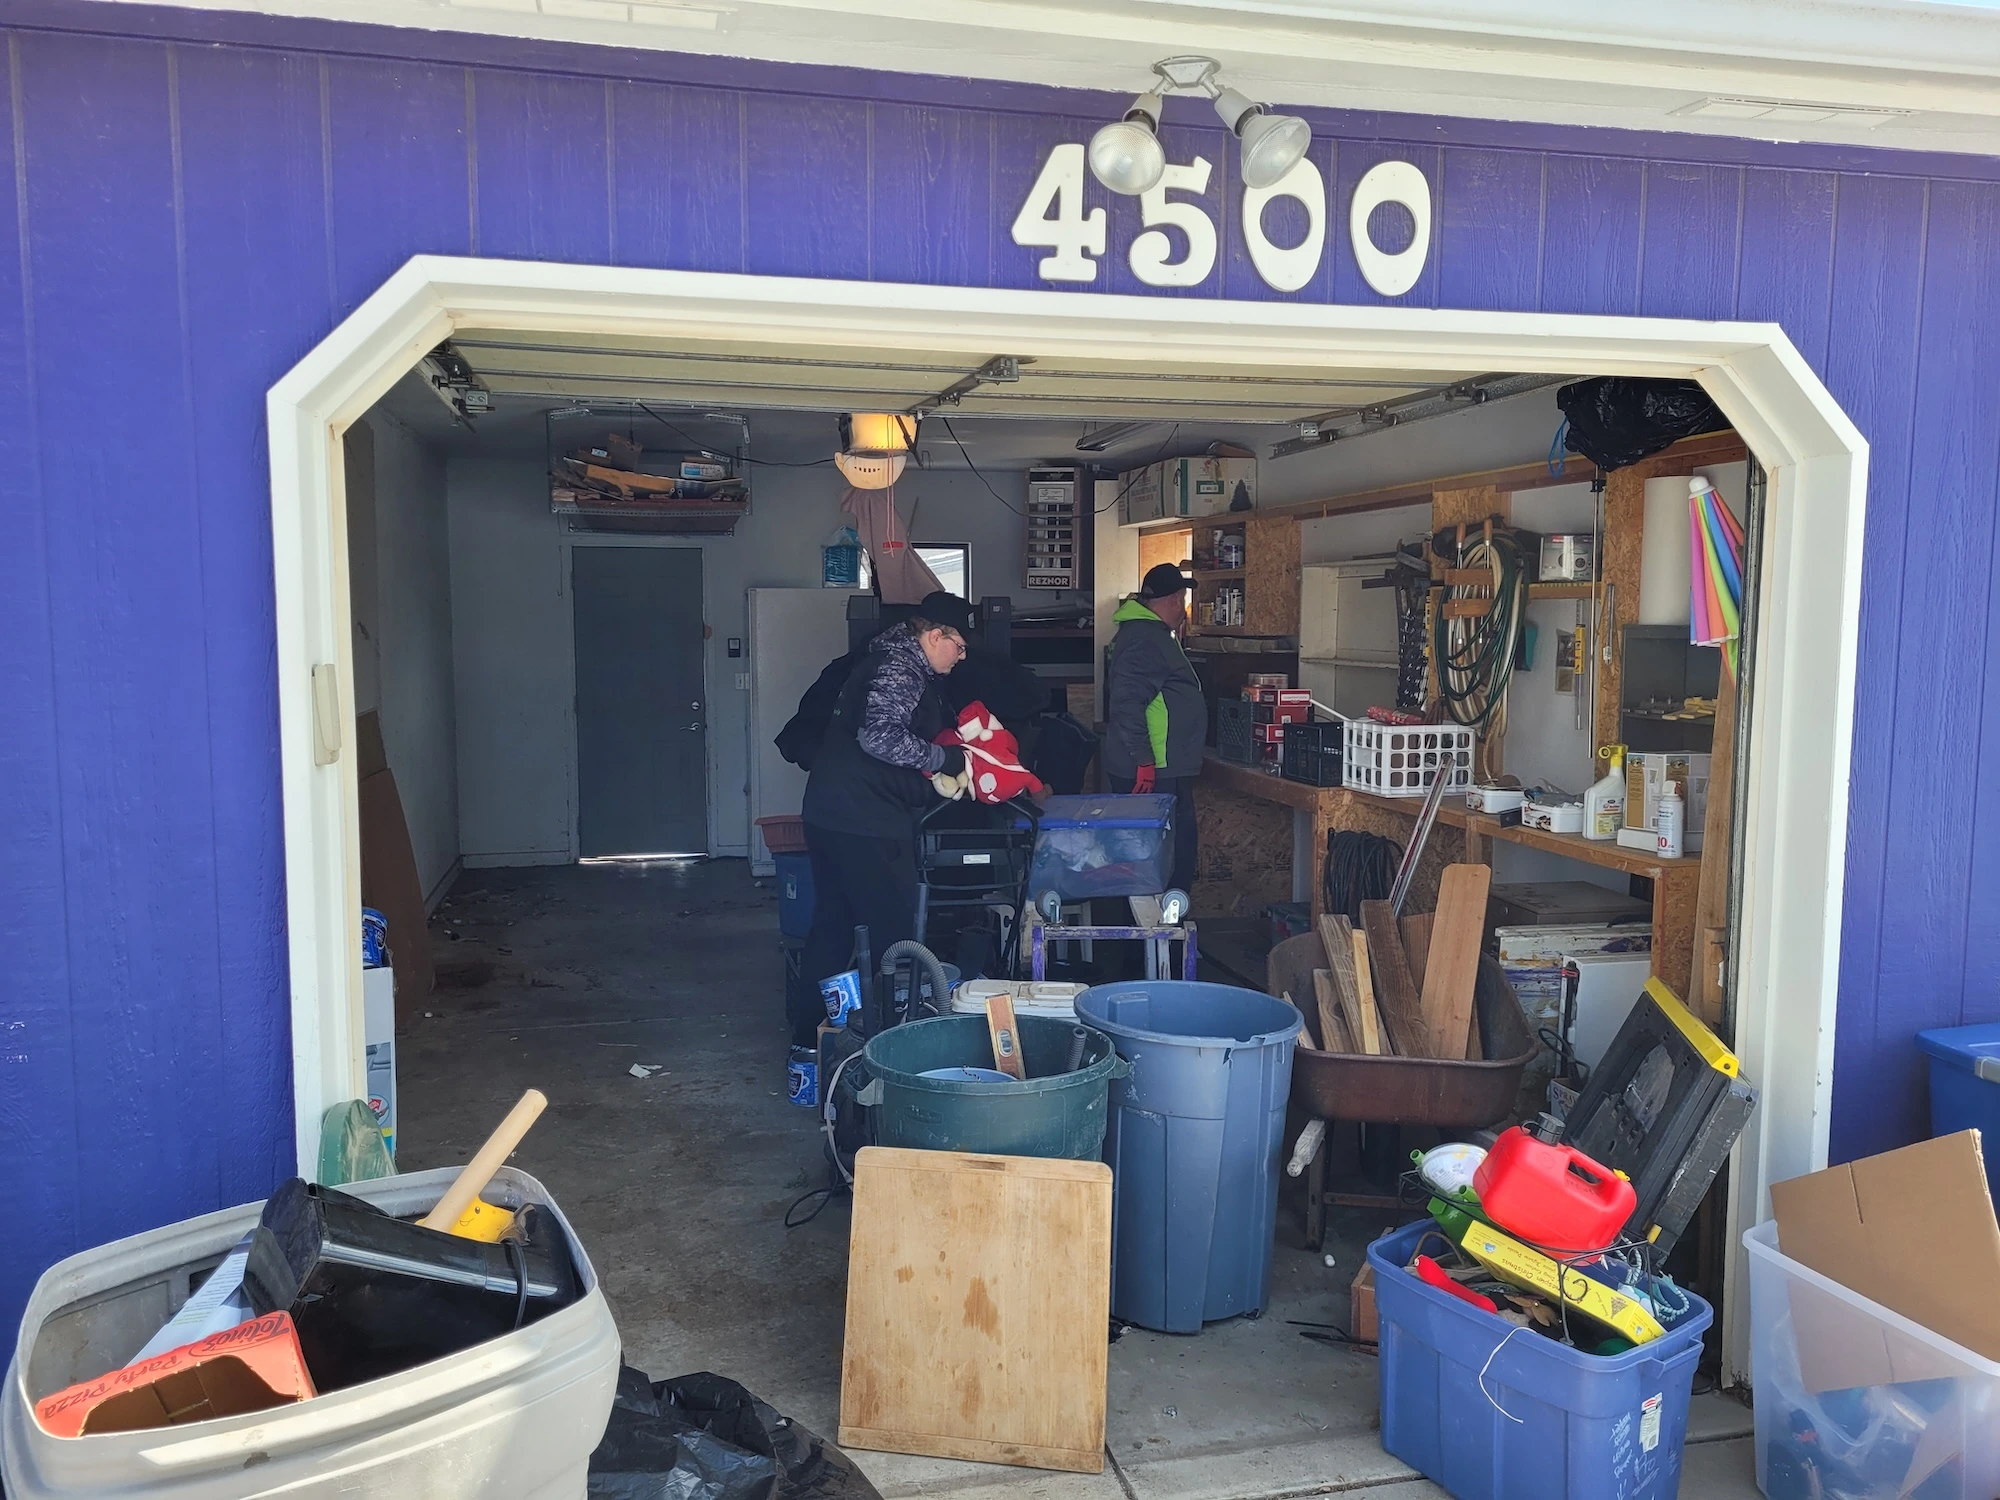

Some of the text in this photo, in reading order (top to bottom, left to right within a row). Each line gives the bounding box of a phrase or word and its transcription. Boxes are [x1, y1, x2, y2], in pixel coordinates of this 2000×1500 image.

[1011, 143, 1432, 297] 4500
[1029, 576, 1069, 586] REZNOR
[1501, 1258, 1533, 1278] Christmas
[43, 1314, 290, 1420] Totino's Party Pizza
